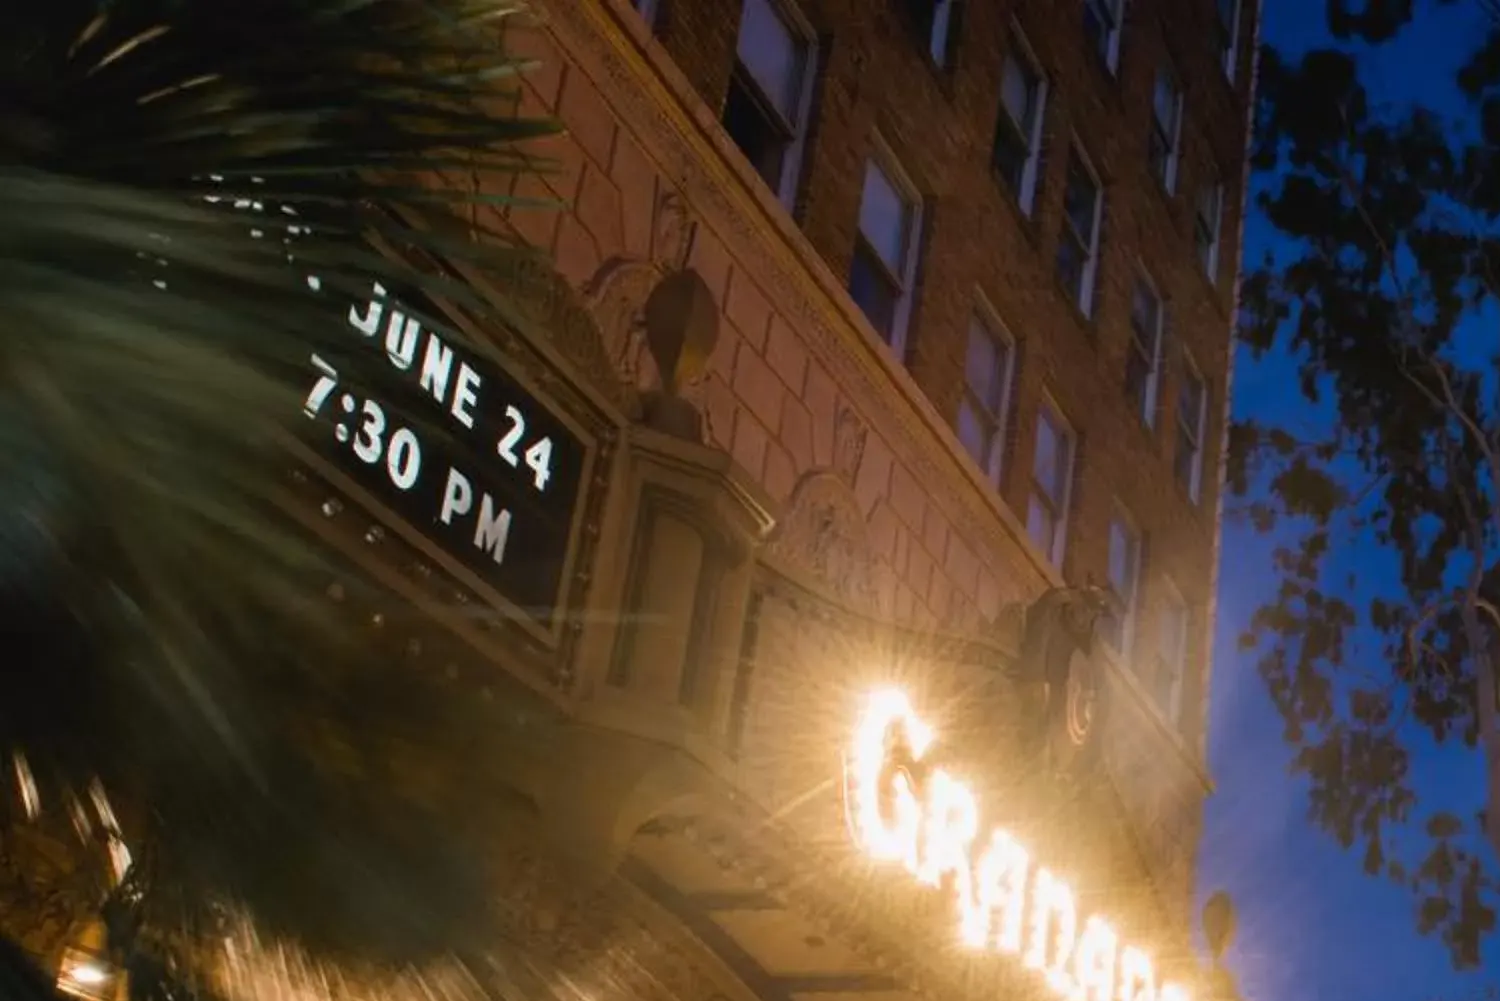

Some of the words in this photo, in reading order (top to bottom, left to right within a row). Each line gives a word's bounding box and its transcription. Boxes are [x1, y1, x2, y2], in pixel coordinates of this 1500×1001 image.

[302, 353, 423, 491] 7:30
[440, 468, 513, 564] PM
[348, 283, 483, 431] JUNE
[497, 407, 555, 492] 24
